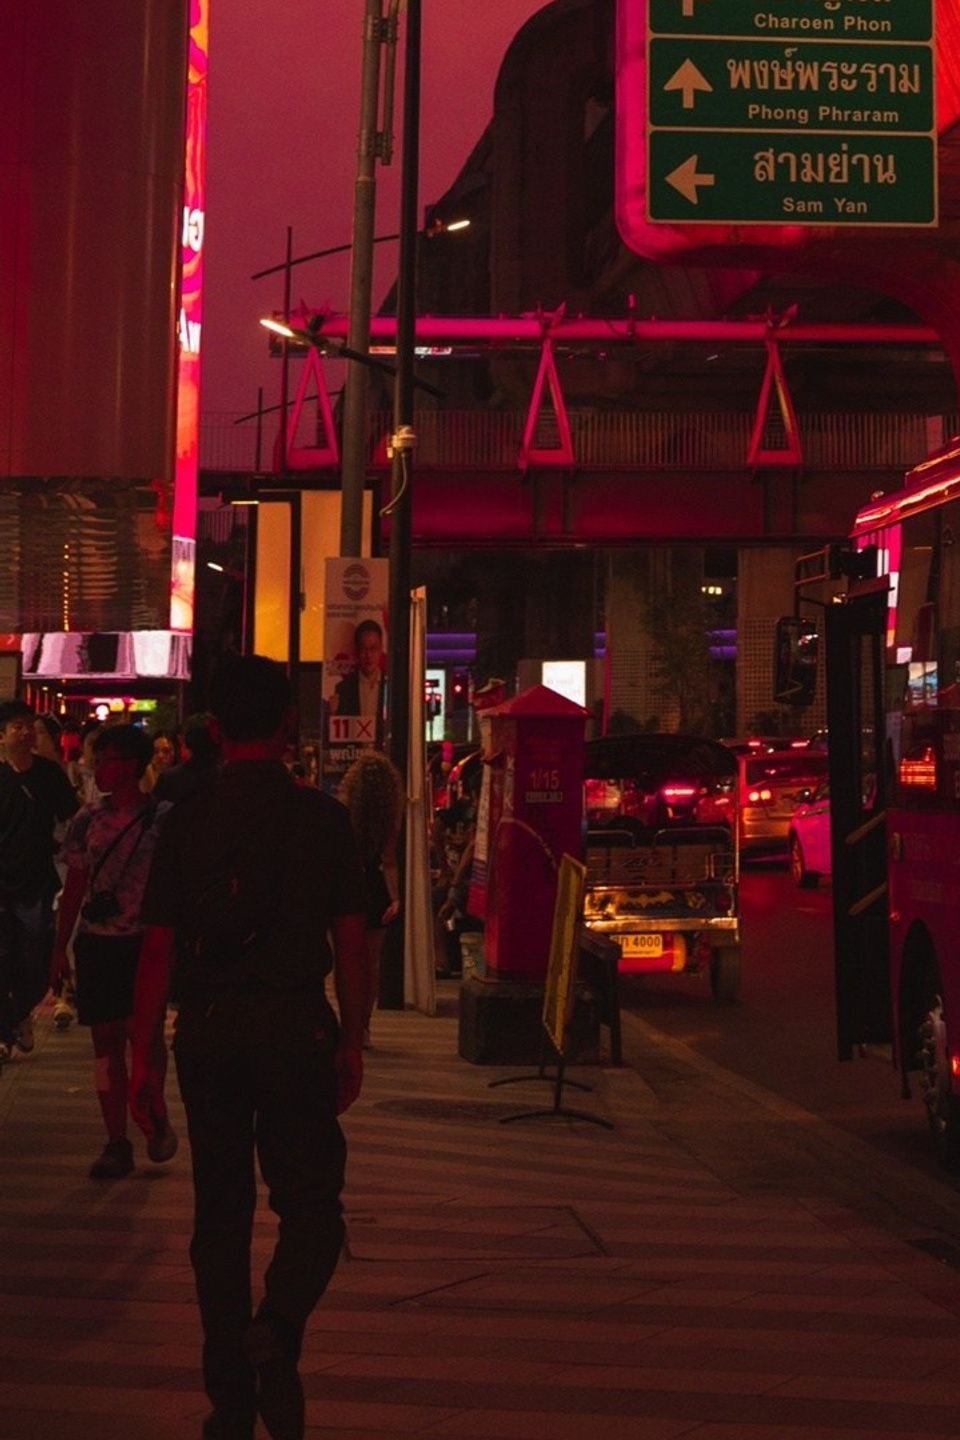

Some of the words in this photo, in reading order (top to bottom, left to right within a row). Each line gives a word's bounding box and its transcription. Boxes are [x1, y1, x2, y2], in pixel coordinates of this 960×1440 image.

[754, 13, 834, 30] Charoen
[844, 16, 892, 32] Phon
[726, 47, 920, 93] พงษ์พระราม
[747, 104, 809, 124] Phong
[819, 106, 899, 123] Phraram
[753, 142, 897, 184] สามย่าน
[782, 197, 823, 213] Sam
[834, 197, 868, 213] Yan
[333, 719, 350, 739] 11
[529, 768, 560, 791] 1/15
[633, 936, 661, 948] 4000
